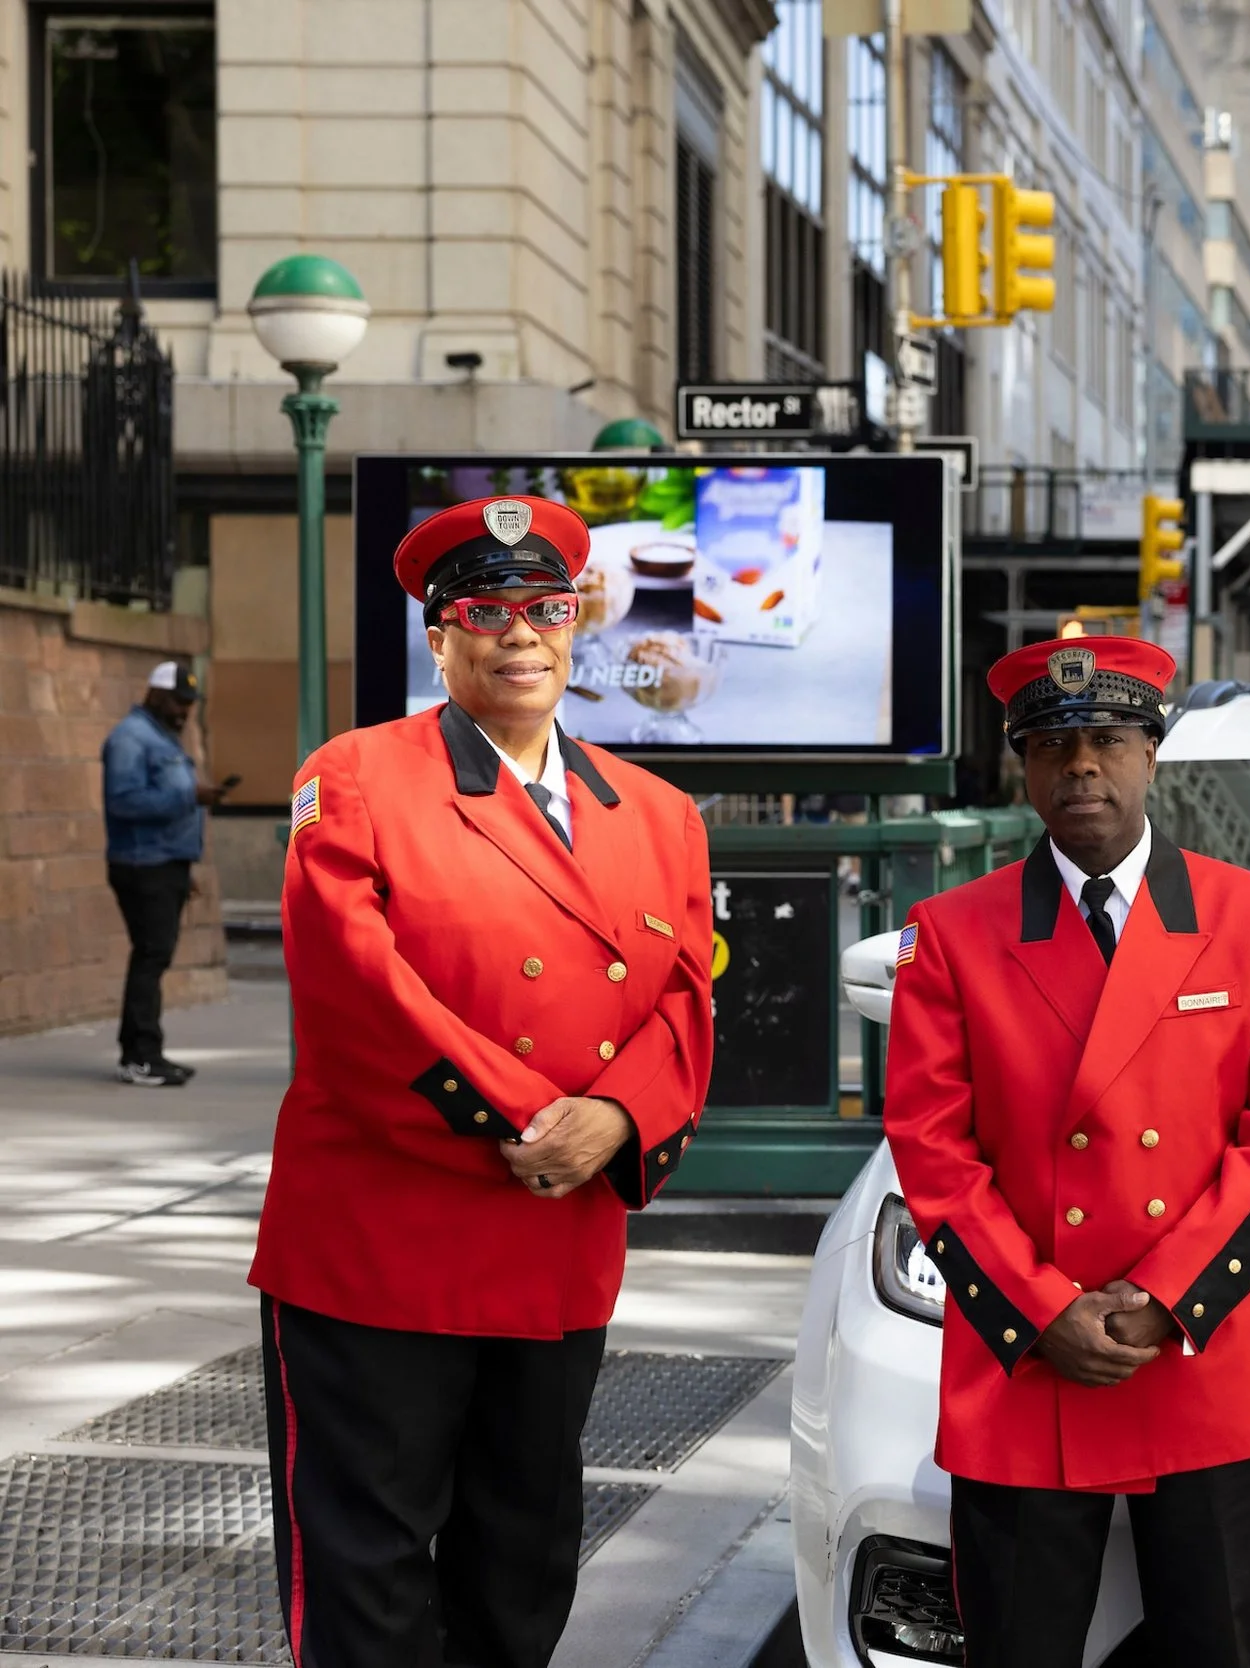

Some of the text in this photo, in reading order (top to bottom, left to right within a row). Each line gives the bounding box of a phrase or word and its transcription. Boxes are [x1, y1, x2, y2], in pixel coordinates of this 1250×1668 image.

[692, 395, 801, 428] Rector St
[497, 514, 520, 522] DOWN
[499, 522, 520, 530] TOWN
[1051, 651, 1092, 665] SECURITY
[590, 663, 664, 688] NEED!
